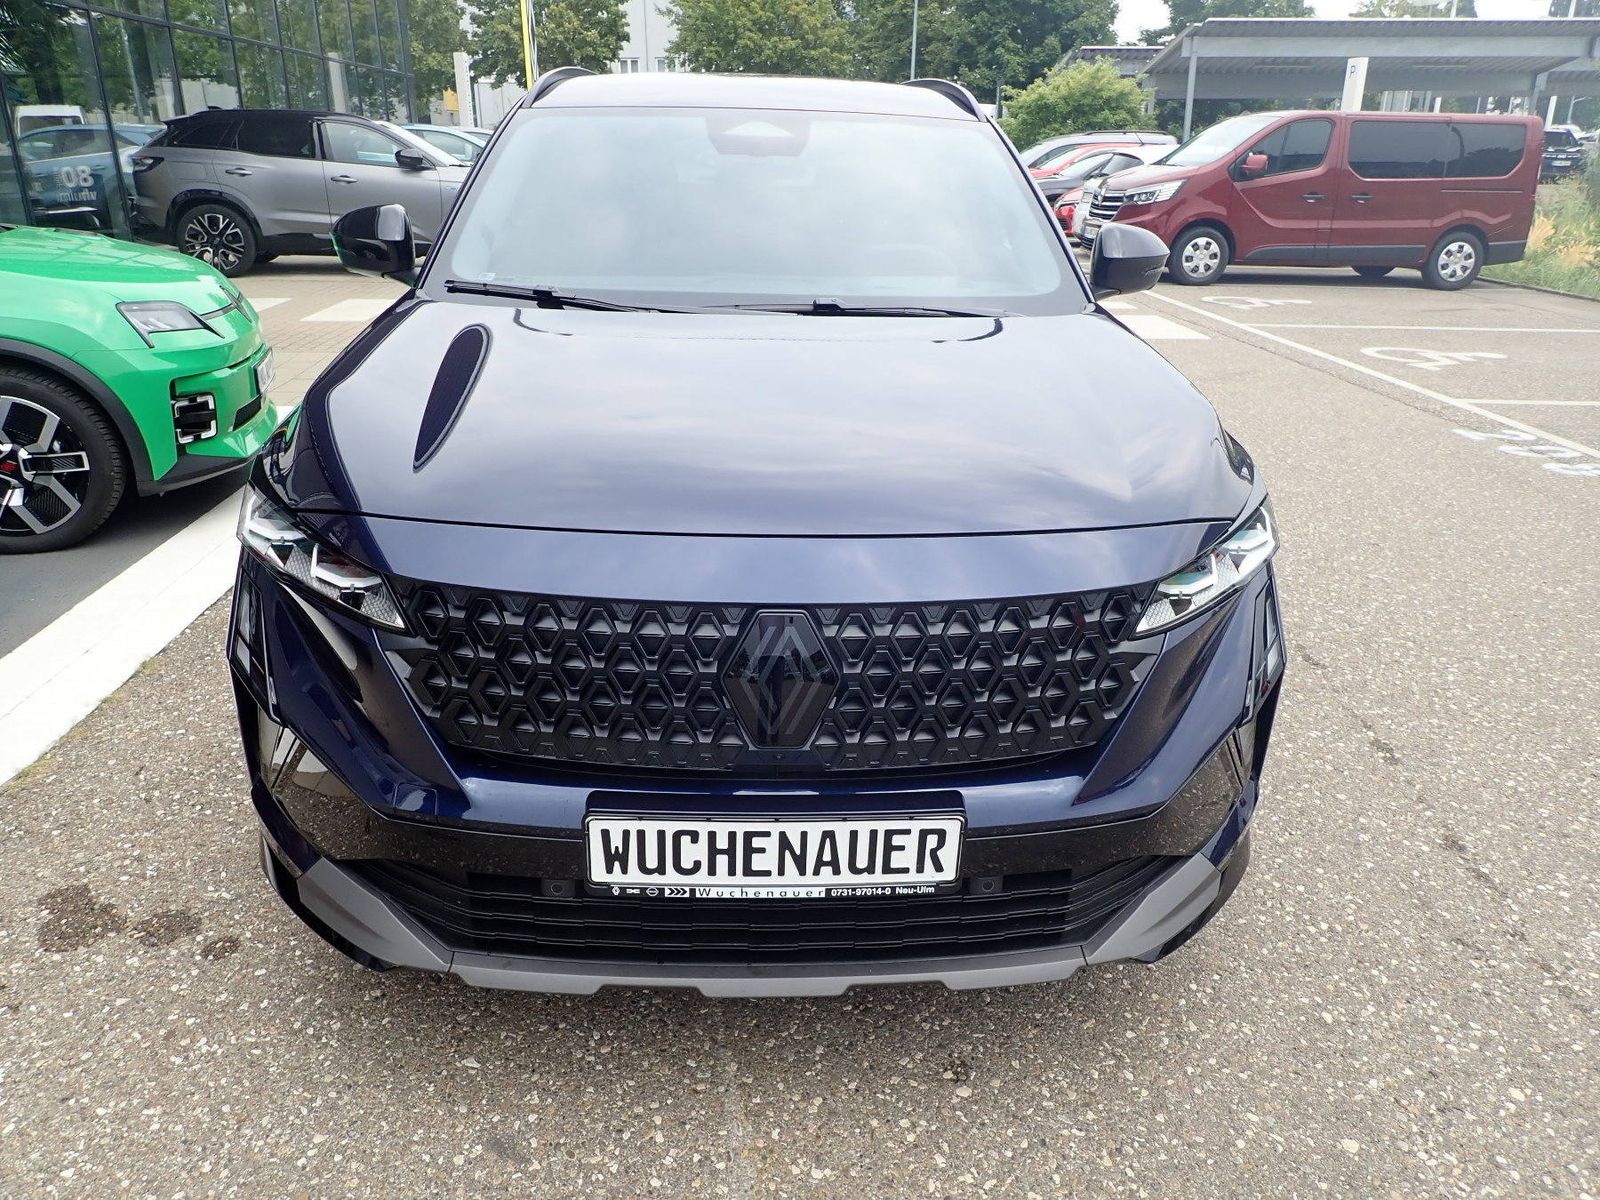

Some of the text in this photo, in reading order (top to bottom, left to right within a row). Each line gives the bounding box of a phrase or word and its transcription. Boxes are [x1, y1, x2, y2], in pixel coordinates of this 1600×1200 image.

[600, 828, 947, 877] WUCHENAUER
[698, 885, 935, 898] Wuchenauer 0731-97014-0 Neu-Ulm
